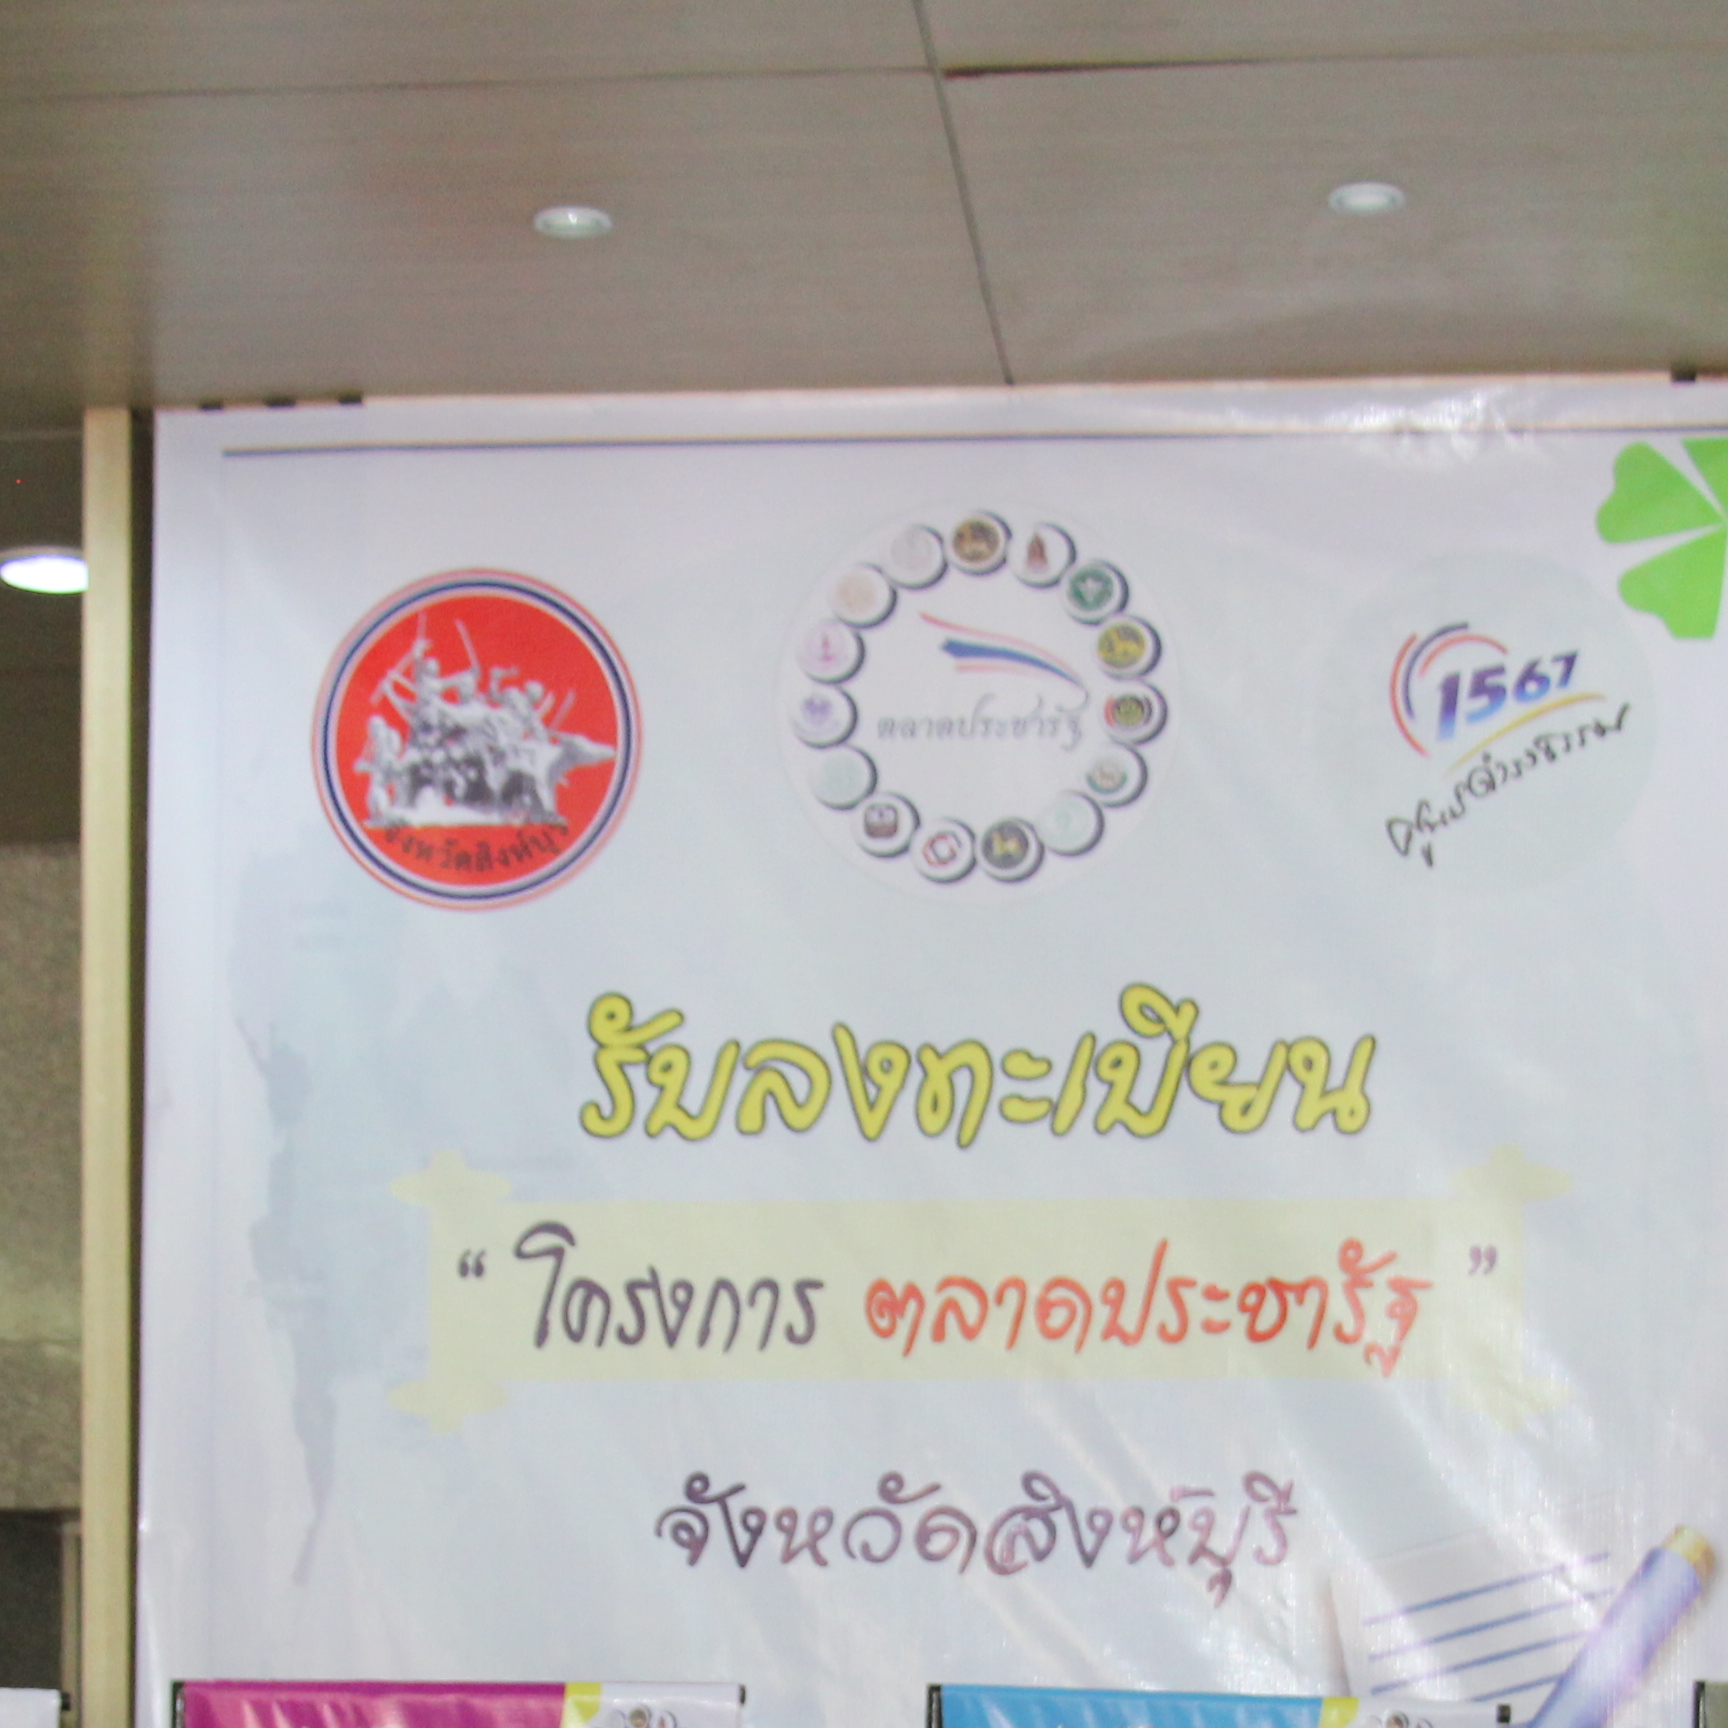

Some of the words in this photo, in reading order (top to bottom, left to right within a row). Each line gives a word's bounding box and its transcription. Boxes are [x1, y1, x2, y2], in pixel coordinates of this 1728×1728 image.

[1436, 650, 1578, 742] 1567
[579, 981, 1378, 1148] รับลงทะเบียน
[513, 1220, 826, 1355] โครงการ
[864, 1239, 1436, 1378] ตลาดประชารัฐ
[652, 1471, 1302, 1611] จังหวัดสิงห์บุรี
